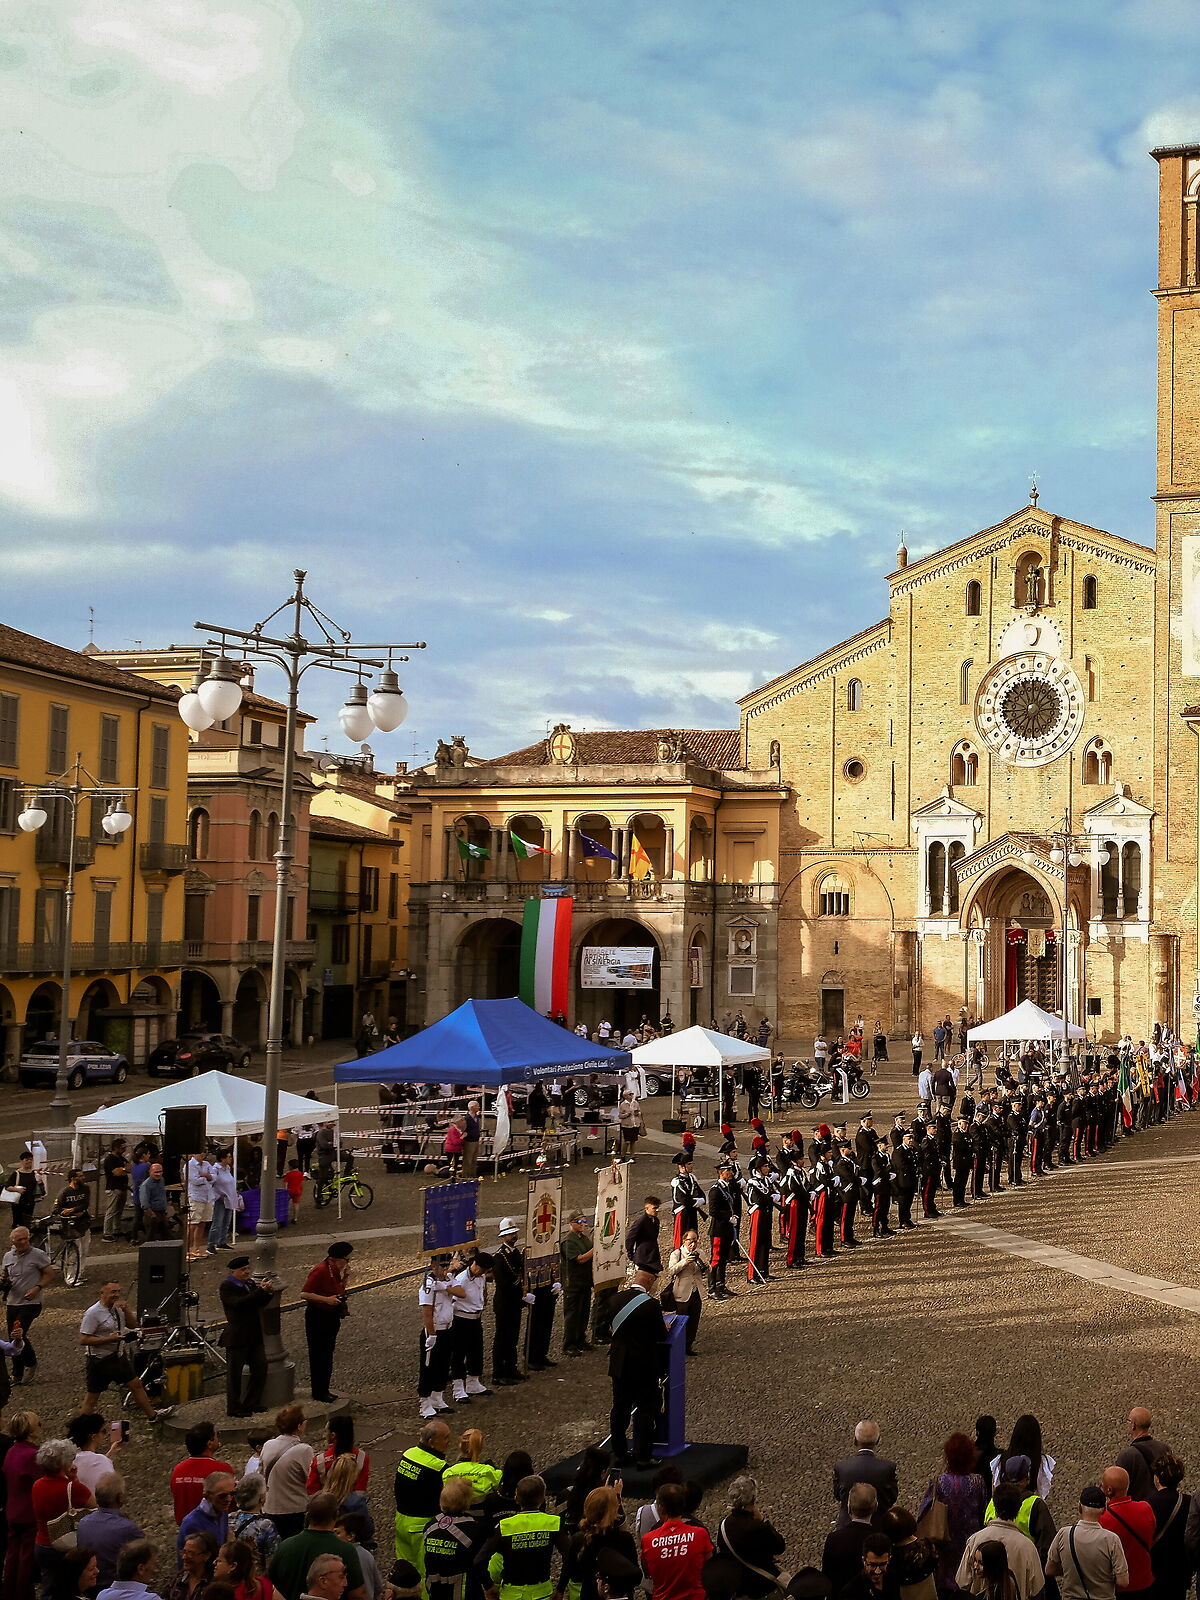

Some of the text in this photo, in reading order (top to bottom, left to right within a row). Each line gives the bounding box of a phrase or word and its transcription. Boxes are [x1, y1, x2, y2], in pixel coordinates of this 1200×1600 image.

[532, 1065, 557, 1076] Volontari
[557, 1063, 584, 1073] Protezione
[584, 1061, 598, 1069] Civile
[651, 1532, 695, 1548] CRISTIAN
[660, 1544, 688, 1559] 3:15
